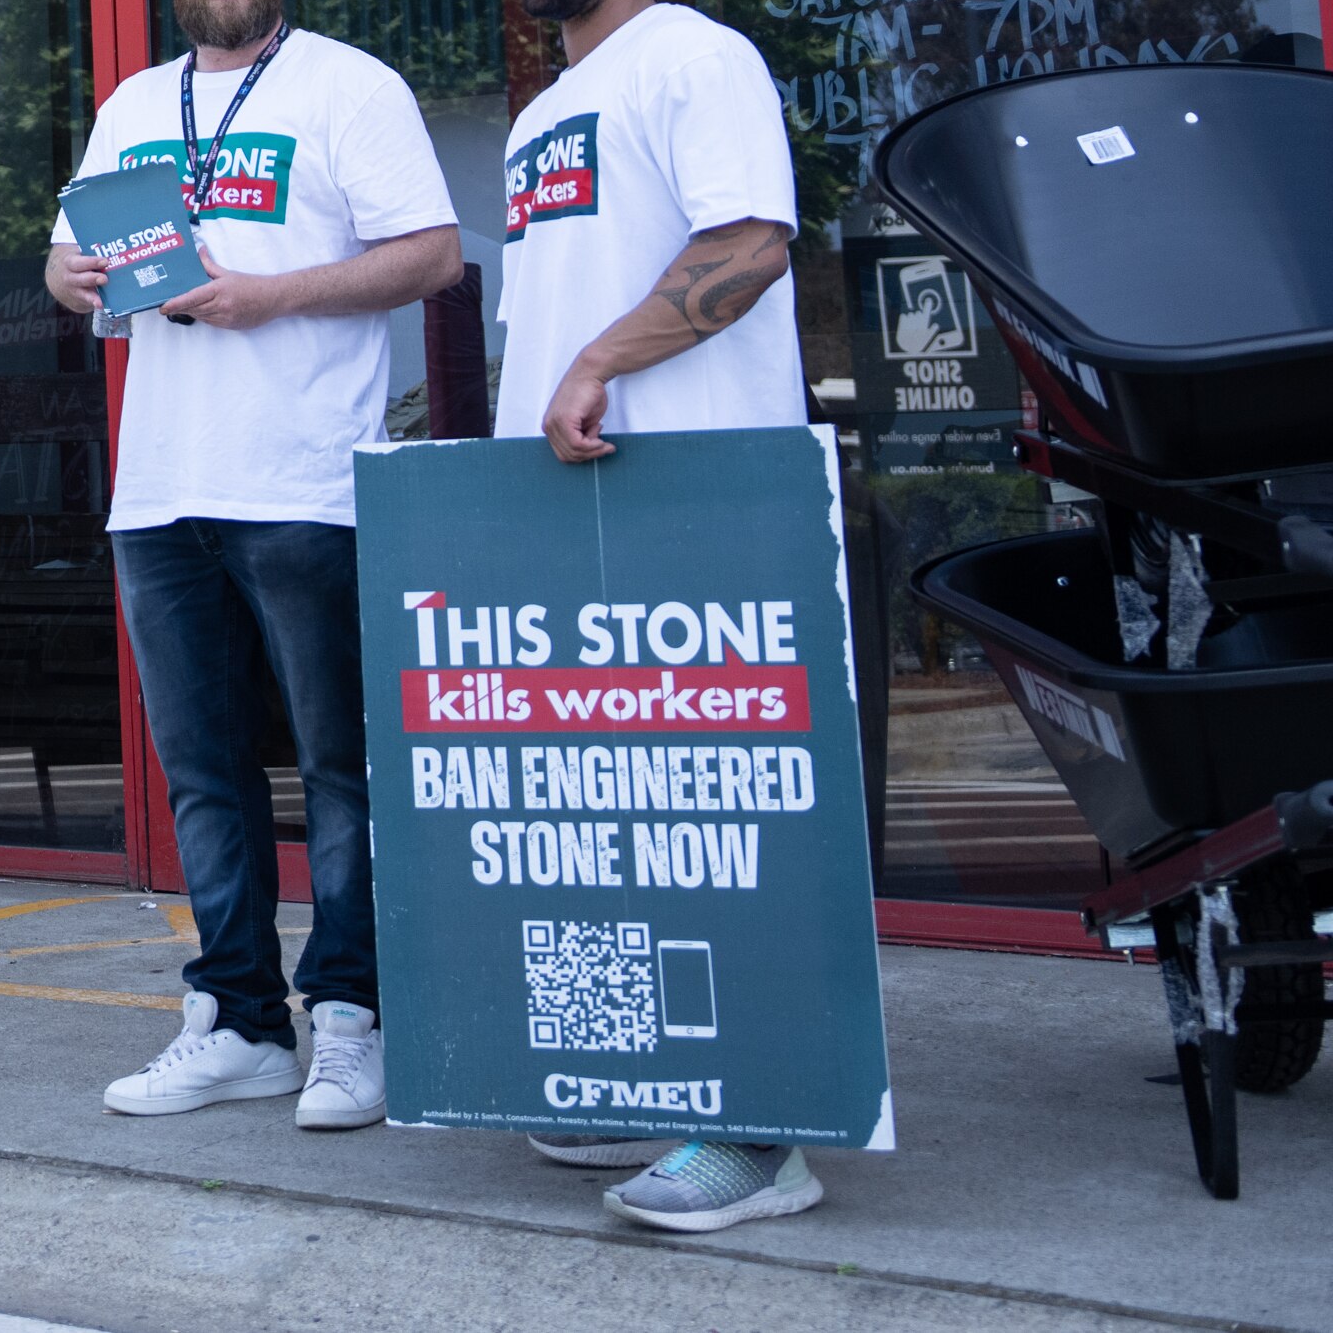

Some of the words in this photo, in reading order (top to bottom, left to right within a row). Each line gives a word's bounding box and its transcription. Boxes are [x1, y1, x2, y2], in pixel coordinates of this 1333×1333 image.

[90, 237, 127, 259] THIS
[129, 221, 177, 248] STONE
[128, 237, 178, 260] workers
[404, 592, 552, 667] THIS
[578, 601, 796, 665] STONE
[427, 673, 532, 721] kills
[545, 671, 787, 721] workers
[412, 747, 510, 809] BAN
[521, 745, 815, 812] ENGINEERED
[471, 821, 622, 886] STONE
[632, 822, 759, 889] NOW
[543, 1072, 723, 1115] CFMEU
